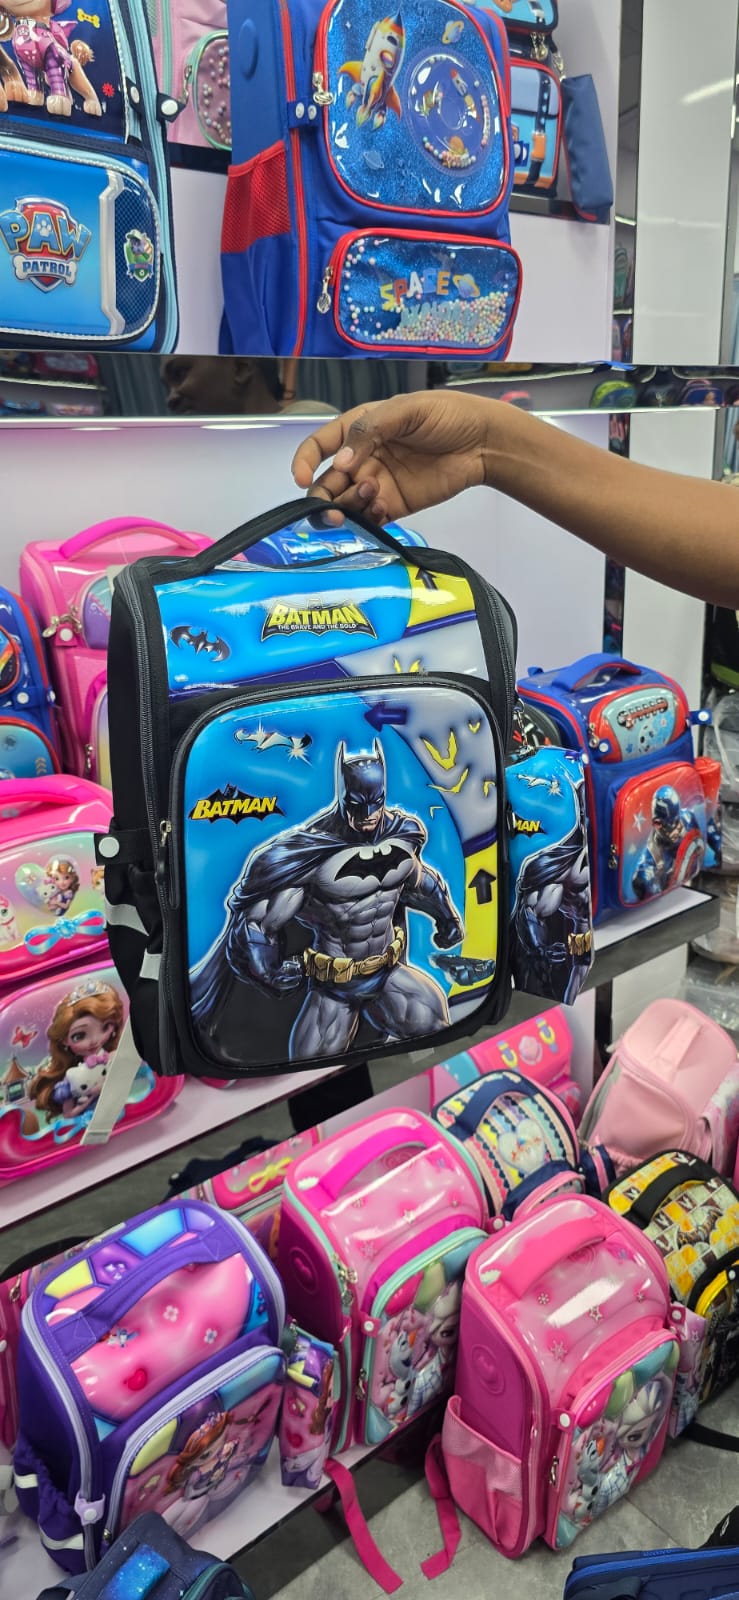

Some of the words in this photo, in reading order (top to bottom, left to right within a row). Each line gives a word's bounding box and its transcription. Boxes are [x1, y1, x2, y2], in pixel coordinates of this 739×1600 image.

[0, 210, 92, 261] PAW
[22, 261, 72, 276] PATROL
[268, 602, 368, 627] BATMAN
[192, 797, 276, 819] BATMAN
